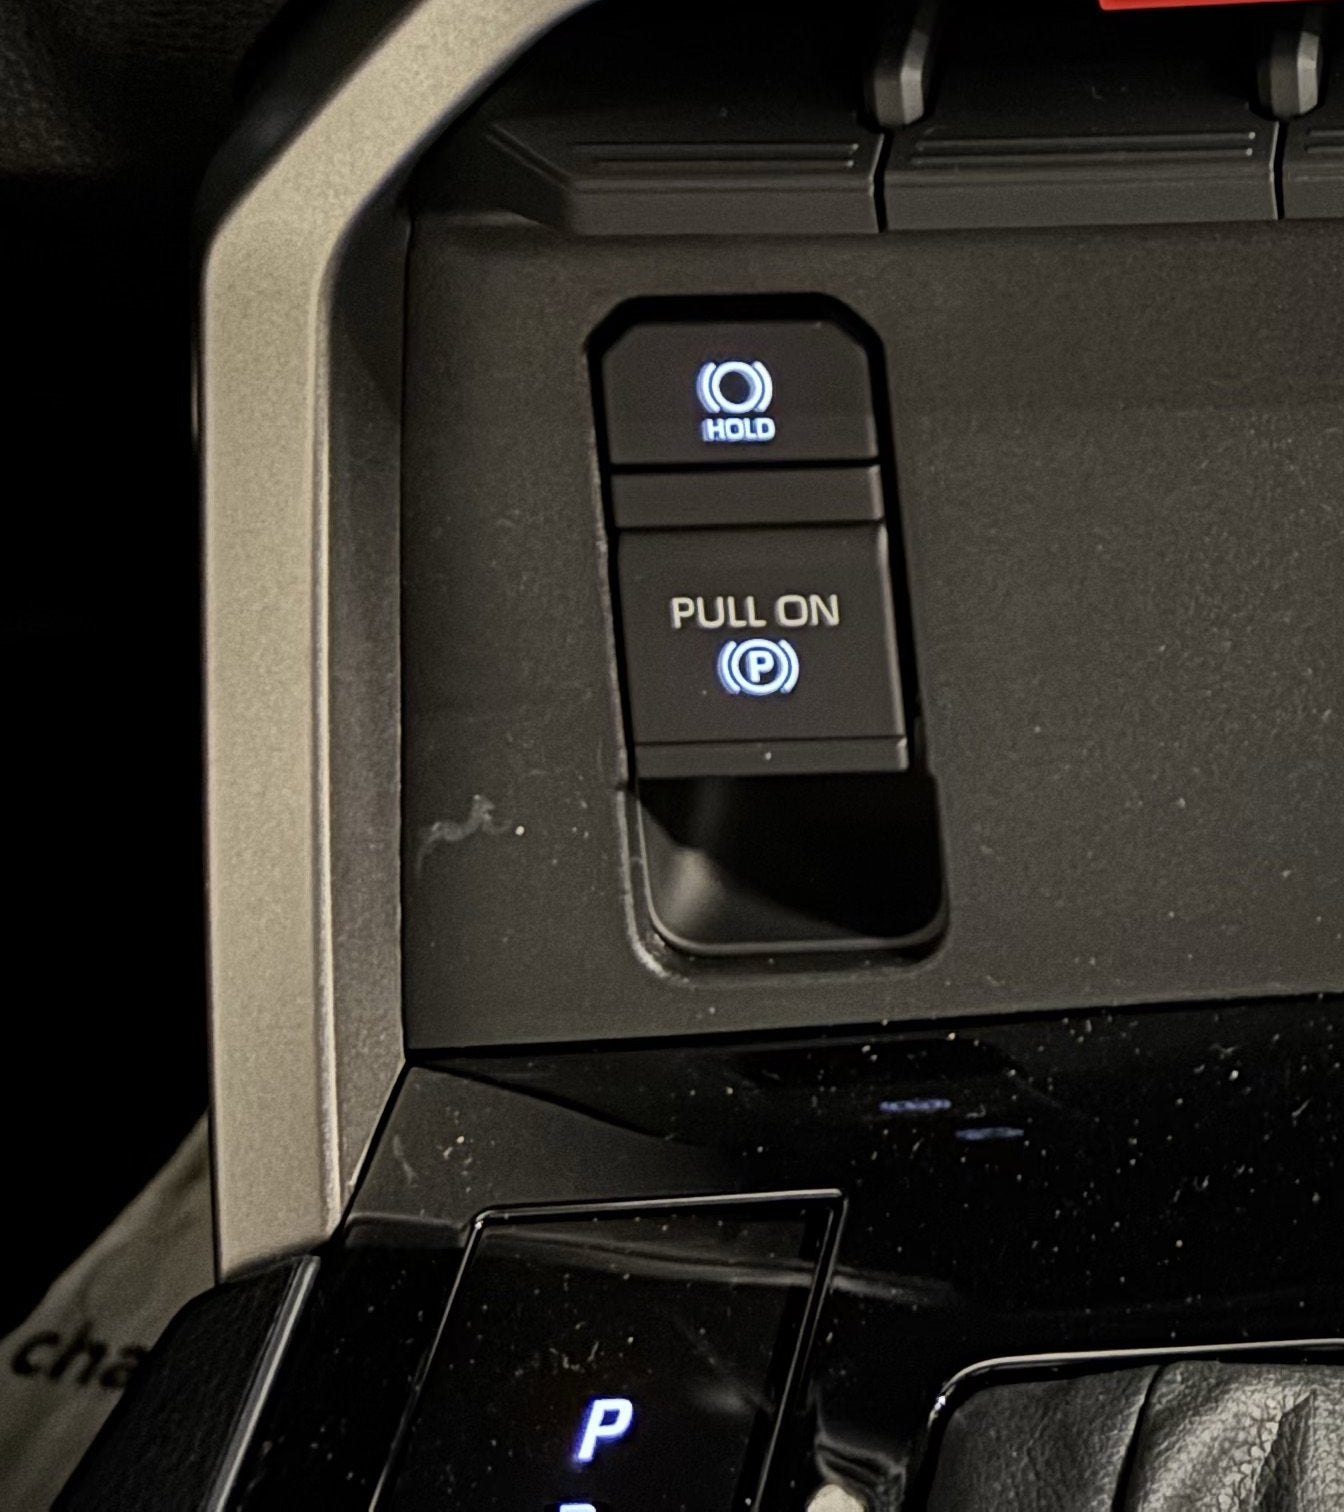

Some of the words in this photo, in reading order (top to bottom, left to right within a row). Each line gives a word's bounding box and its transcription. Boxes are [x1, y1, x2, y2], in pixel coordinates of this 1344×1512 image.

[702, 417, 776, 442] HOLD
[671, 596, 767, 629] PULL
[776, 594, 840, 627] ON
[574, 1397, 634, 1463] P
